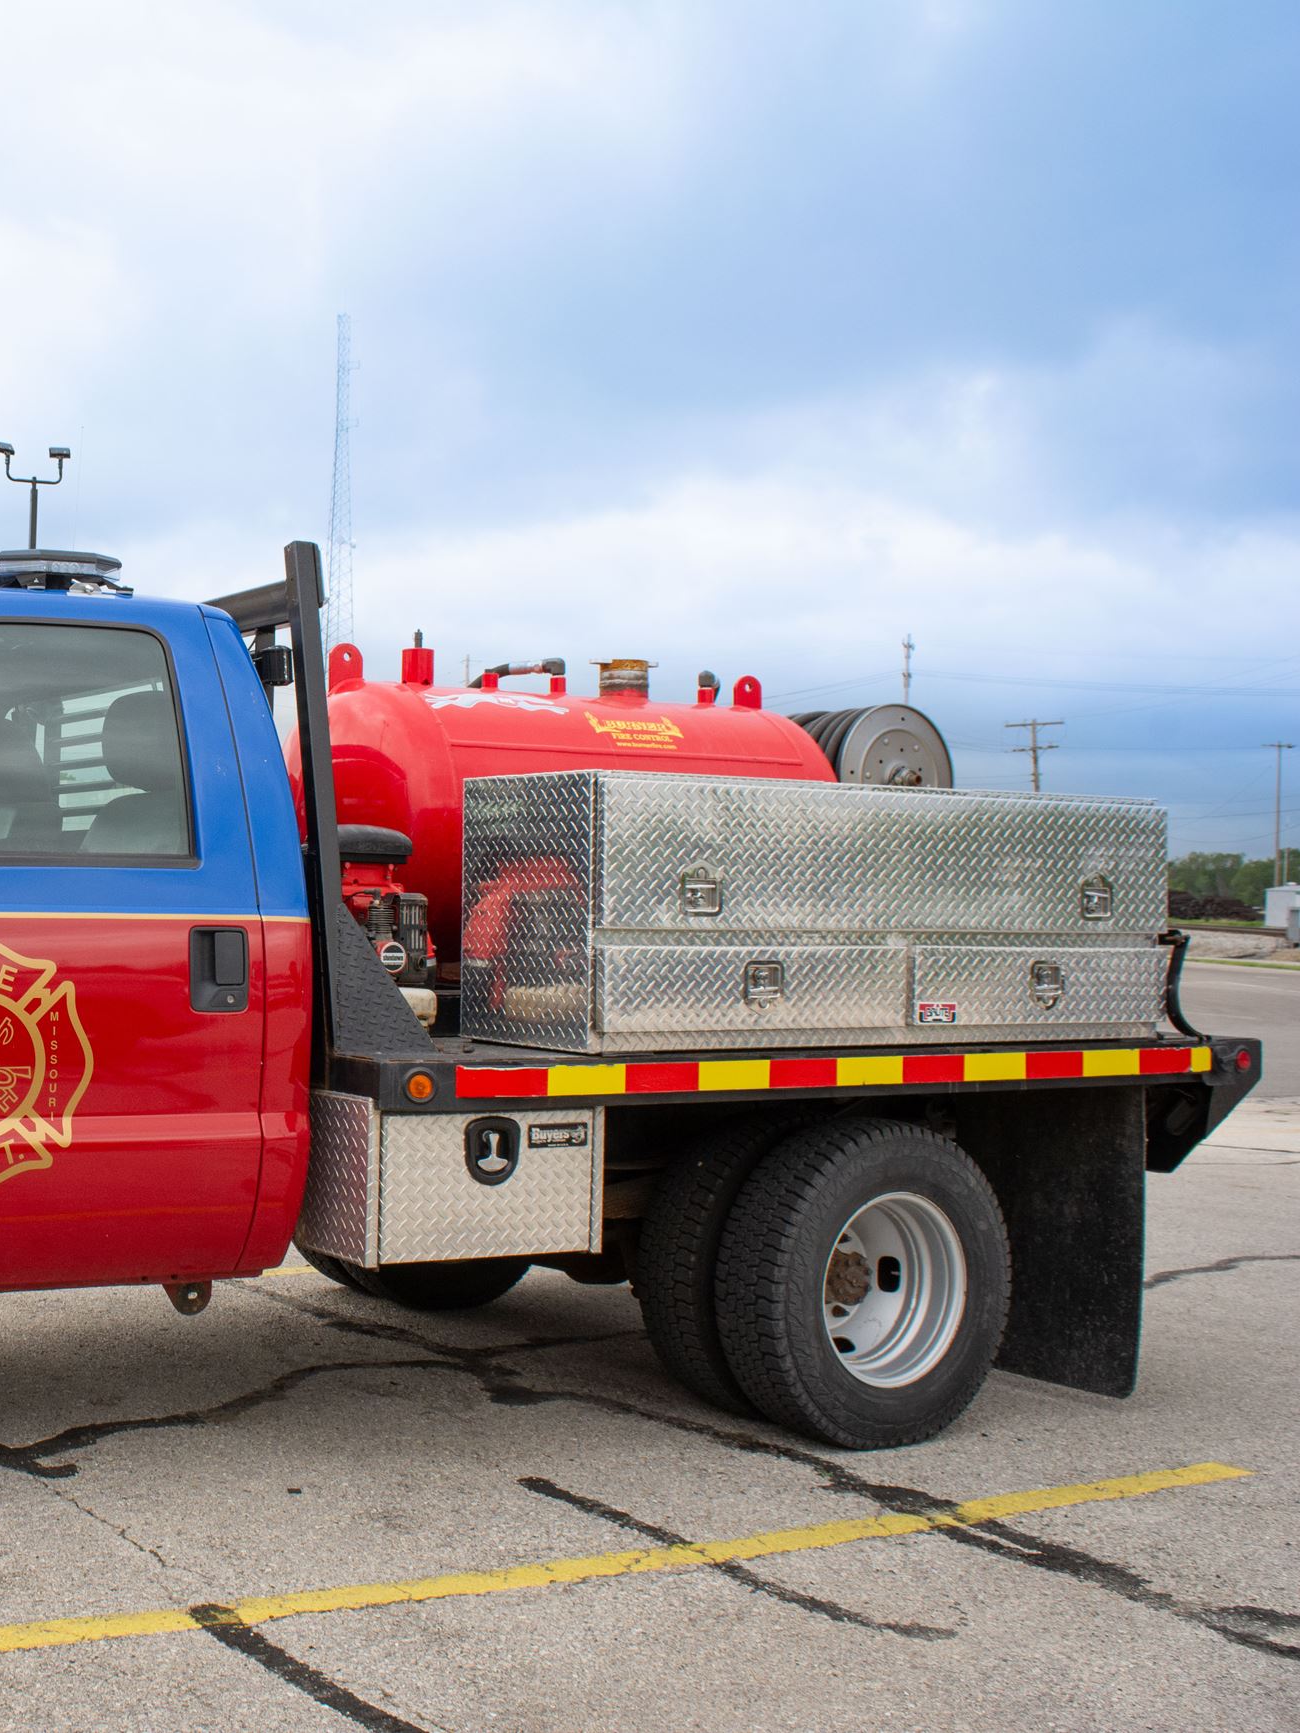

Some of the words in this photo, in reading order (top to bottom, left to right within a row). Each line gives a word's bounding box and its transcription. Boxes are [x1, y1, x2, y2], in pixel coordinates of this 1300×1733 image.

[633, 734, 674, 742] CONTROL
[48, 1011, 59, 1122] MISSOURI
[531, 1127, 570, 1143] Buyers
